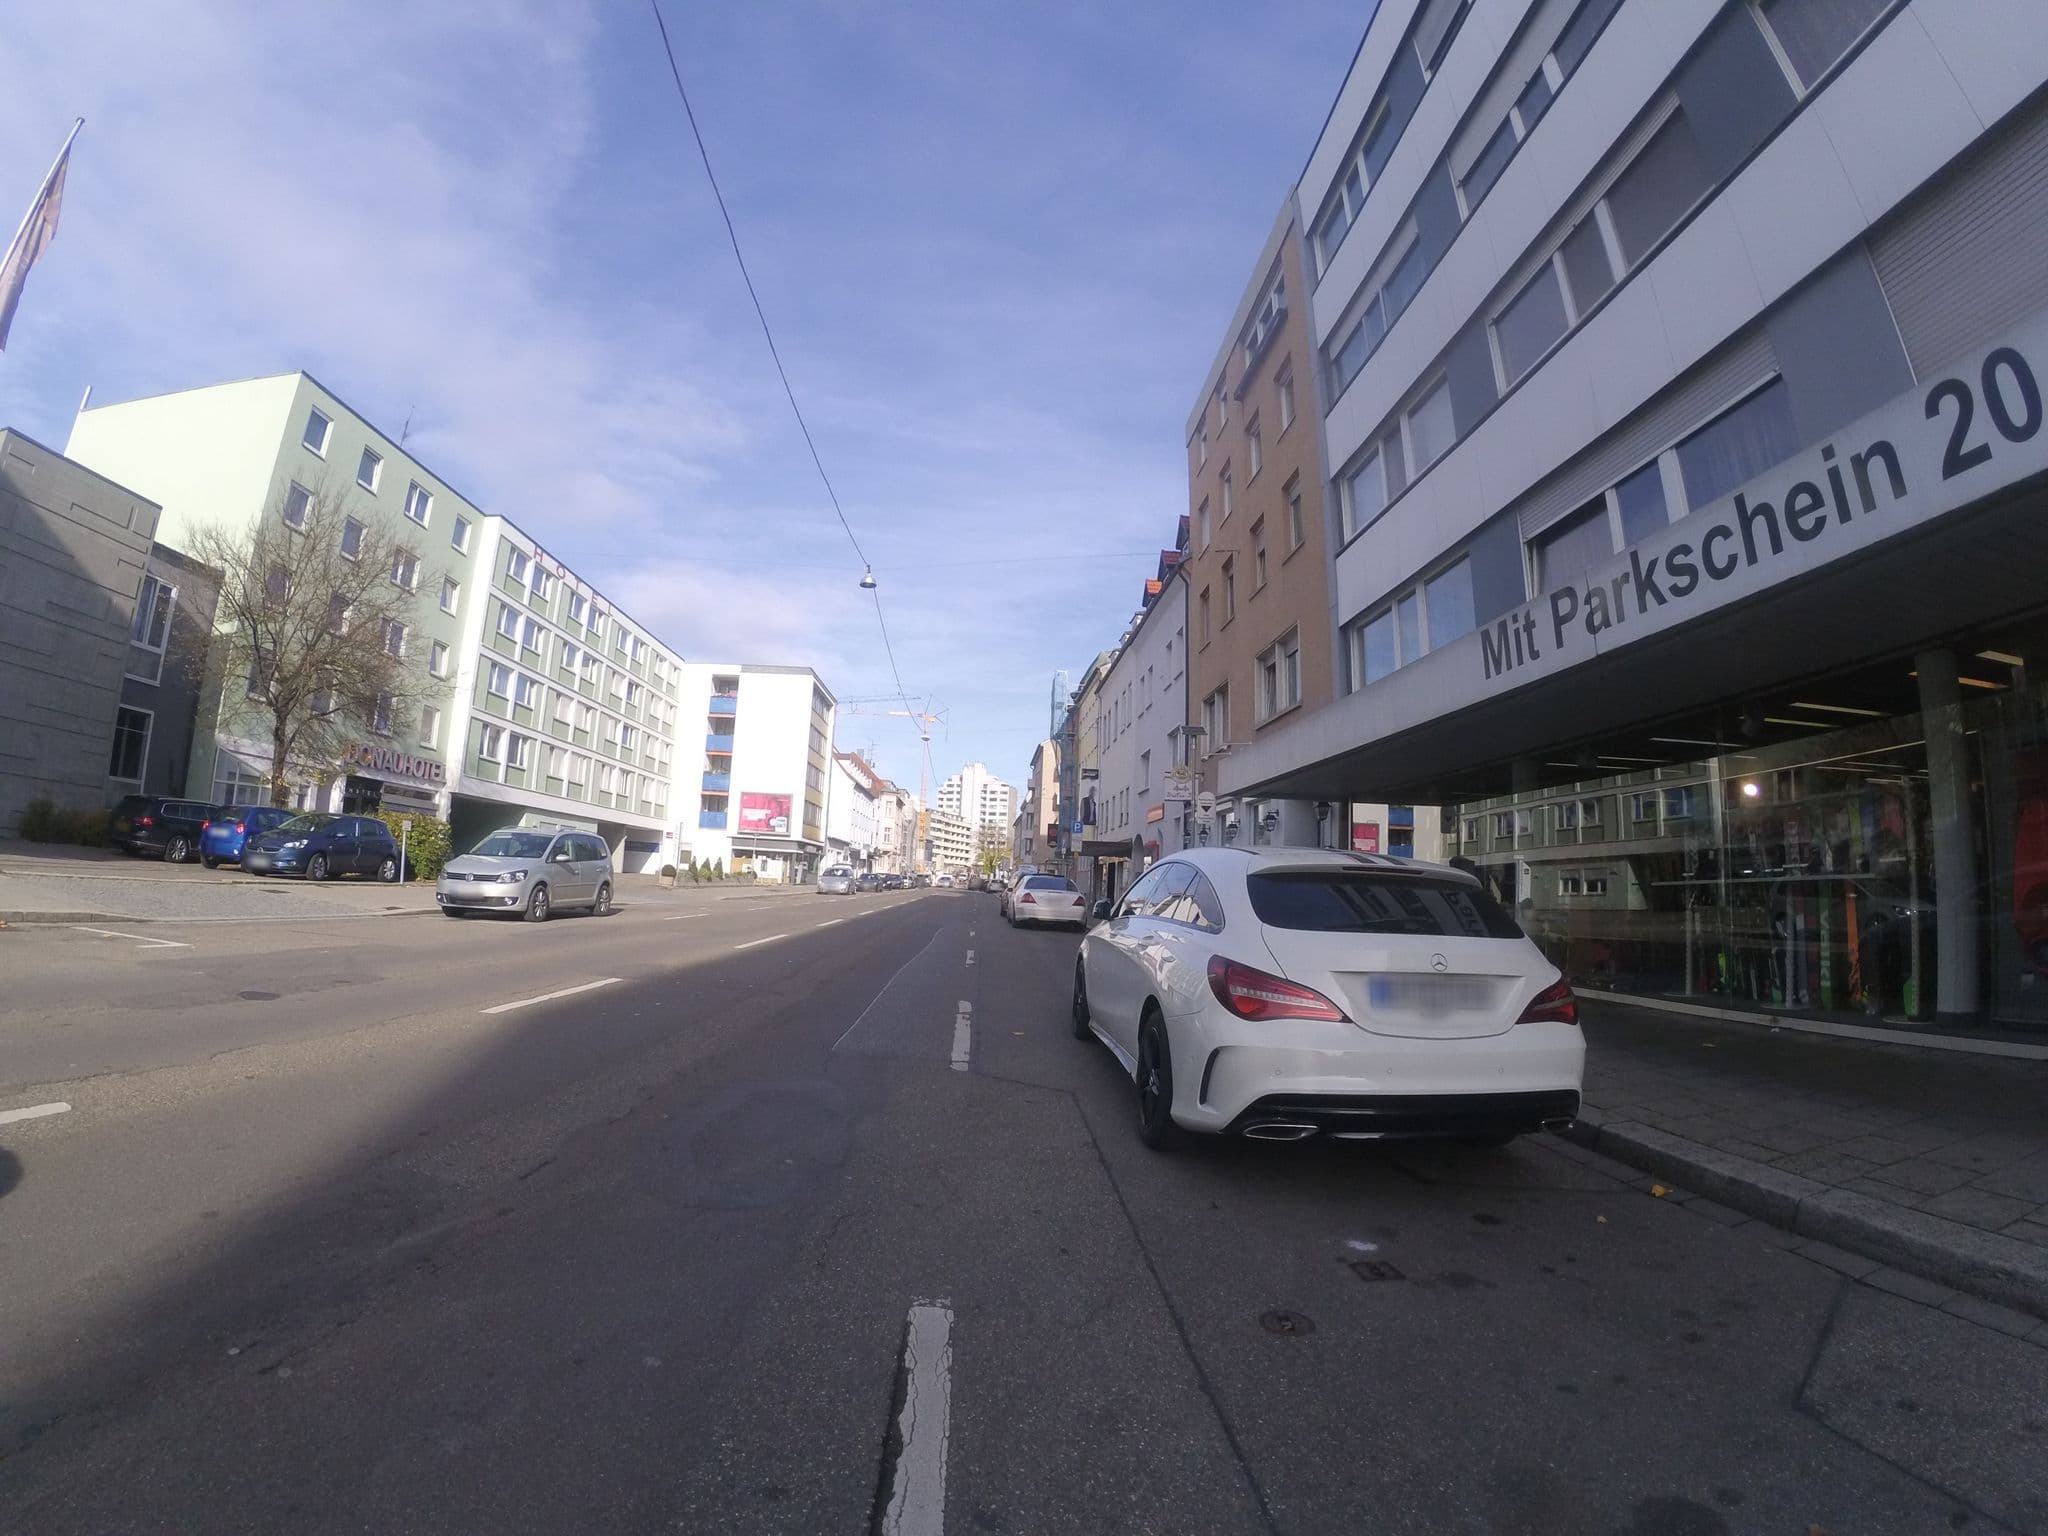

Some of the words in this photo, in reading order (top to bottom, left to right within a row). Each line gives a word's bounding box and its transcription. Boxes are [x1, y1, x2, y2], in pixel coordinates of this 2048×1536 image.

[1481, 610, 1540, 680] Mit
[1551, 439, 1907, 650] Parkschein
[1924, 346, 2044, 481] 20
